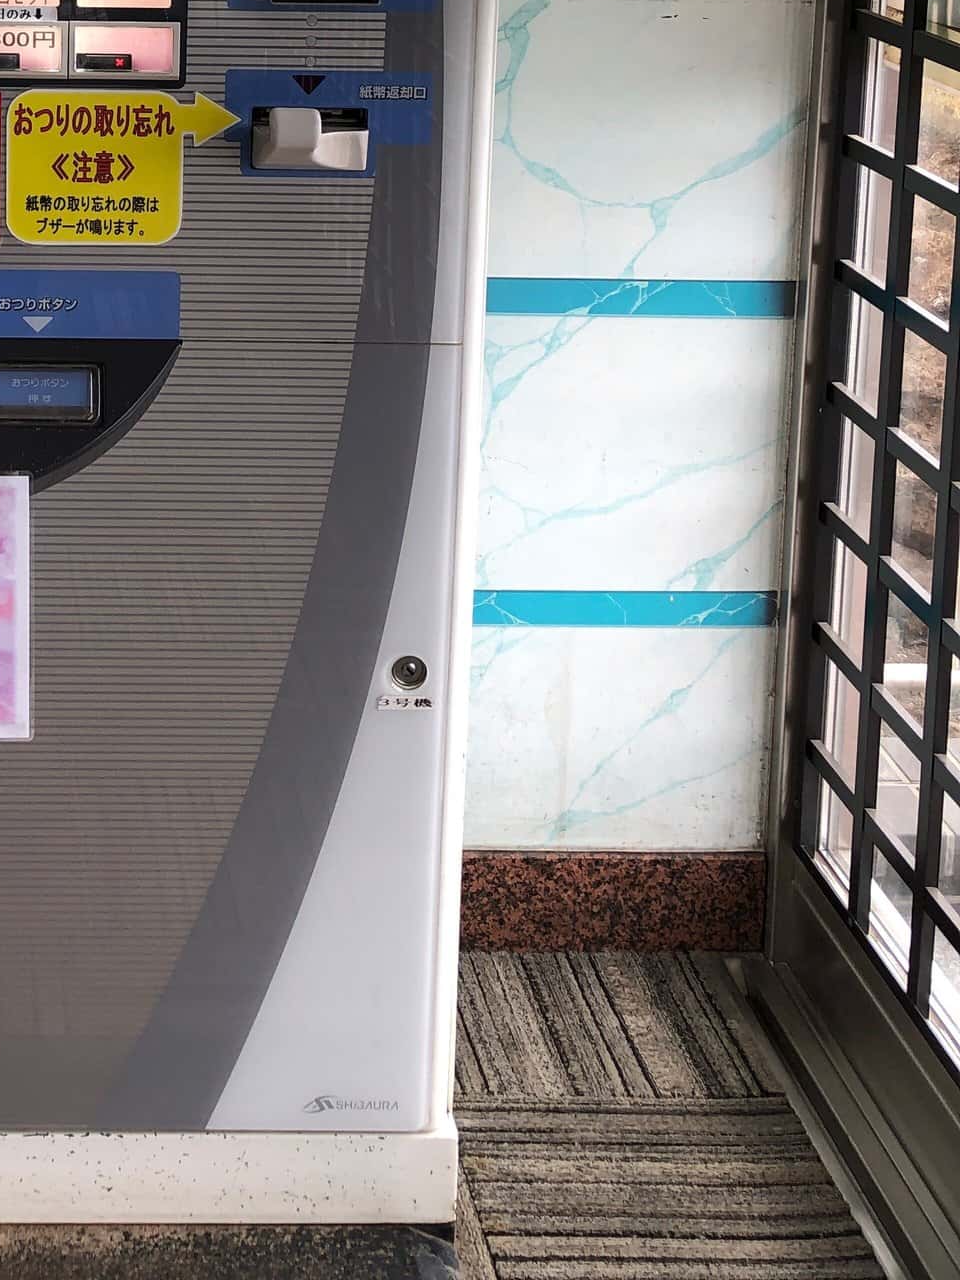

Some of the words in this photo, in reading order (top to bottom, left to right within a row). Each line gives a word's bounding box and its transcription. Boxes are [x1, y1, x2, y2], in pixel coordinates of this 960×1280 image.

[360, 86, 426, 100] 紙幣返却口
[14, 103, 175, 137] おつりの取り忘れ
[52, 150, 134, 183] 《注意》
[26, 195, 159, 213] 紙幣の取り忘れの際は
[37, 219, 144, 236] ブザーが鳴ります。
[0, 298, 78, 311] おつりボタン
